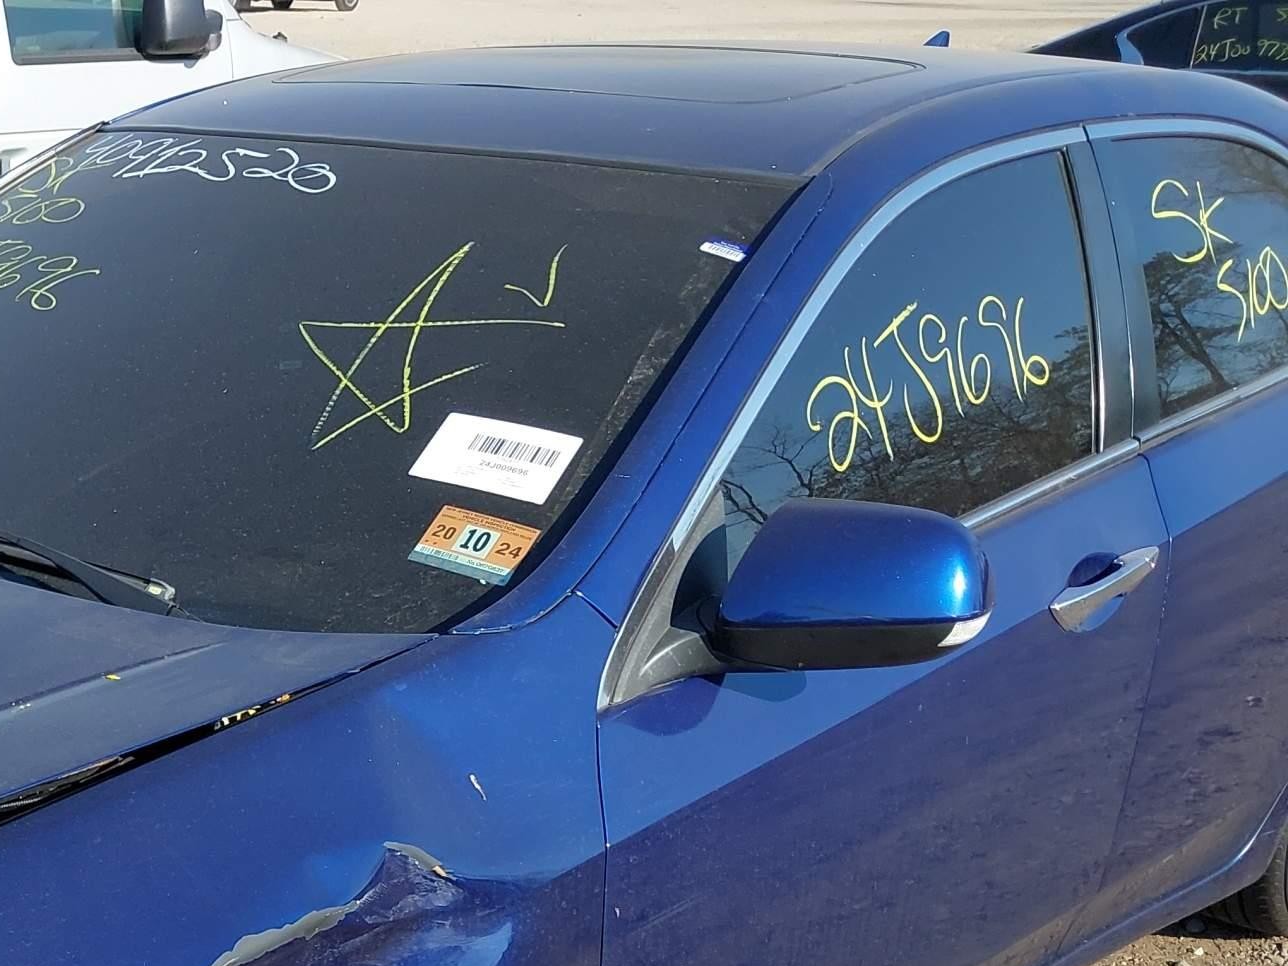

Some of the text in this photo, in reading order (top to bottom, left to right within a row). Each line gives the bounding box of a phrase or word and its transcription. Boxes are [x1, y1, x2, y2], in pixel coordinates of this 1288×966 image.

[806, 294, 1050, 473] 24J9696
[431, 523, 458, 541] 20
[459, 528, 492, 553] 10
[494, 542, 523, 559] 24
